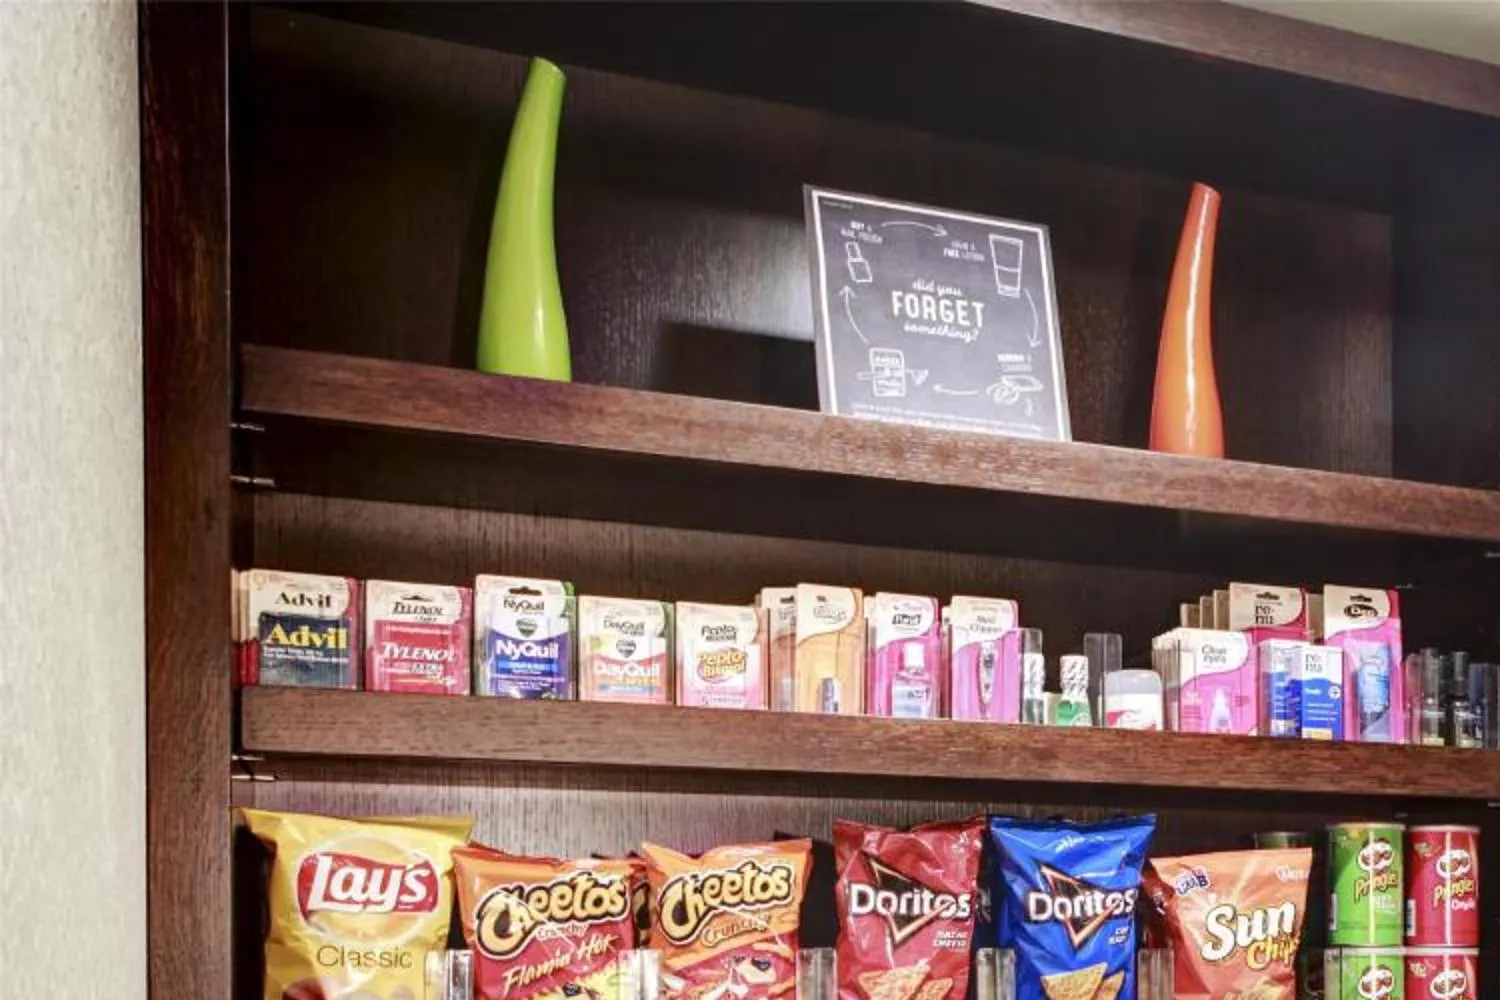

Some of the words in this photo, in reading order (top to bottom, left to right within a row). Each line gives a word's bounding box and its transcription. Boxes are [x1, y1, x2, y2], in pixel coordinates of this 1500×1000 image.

[891, 290, 985, 328] FORGET
[904, 321, 979, 344] something?
[275, 592, 331, 608] Advil
[503, 598, 545, 613] NyQuil
[266, 623, 348, 649] Advil
[380, 640, 456, 663] TYLENOL
[495, 639, 559, 661] NyQuil
[309, 854, 431, 913] Lay's
[477, 873, 629, 956] Cheetos
[659, 860, 794, 944] Cheetos
[850, 883, 971, 920] Doritos
[1028, 889, 1135, 922] Doritos
[1202, 901, 1295, 961] Sun
[316, 944, 413, 970] Classic
[575, 933, 620, 965] Hot
